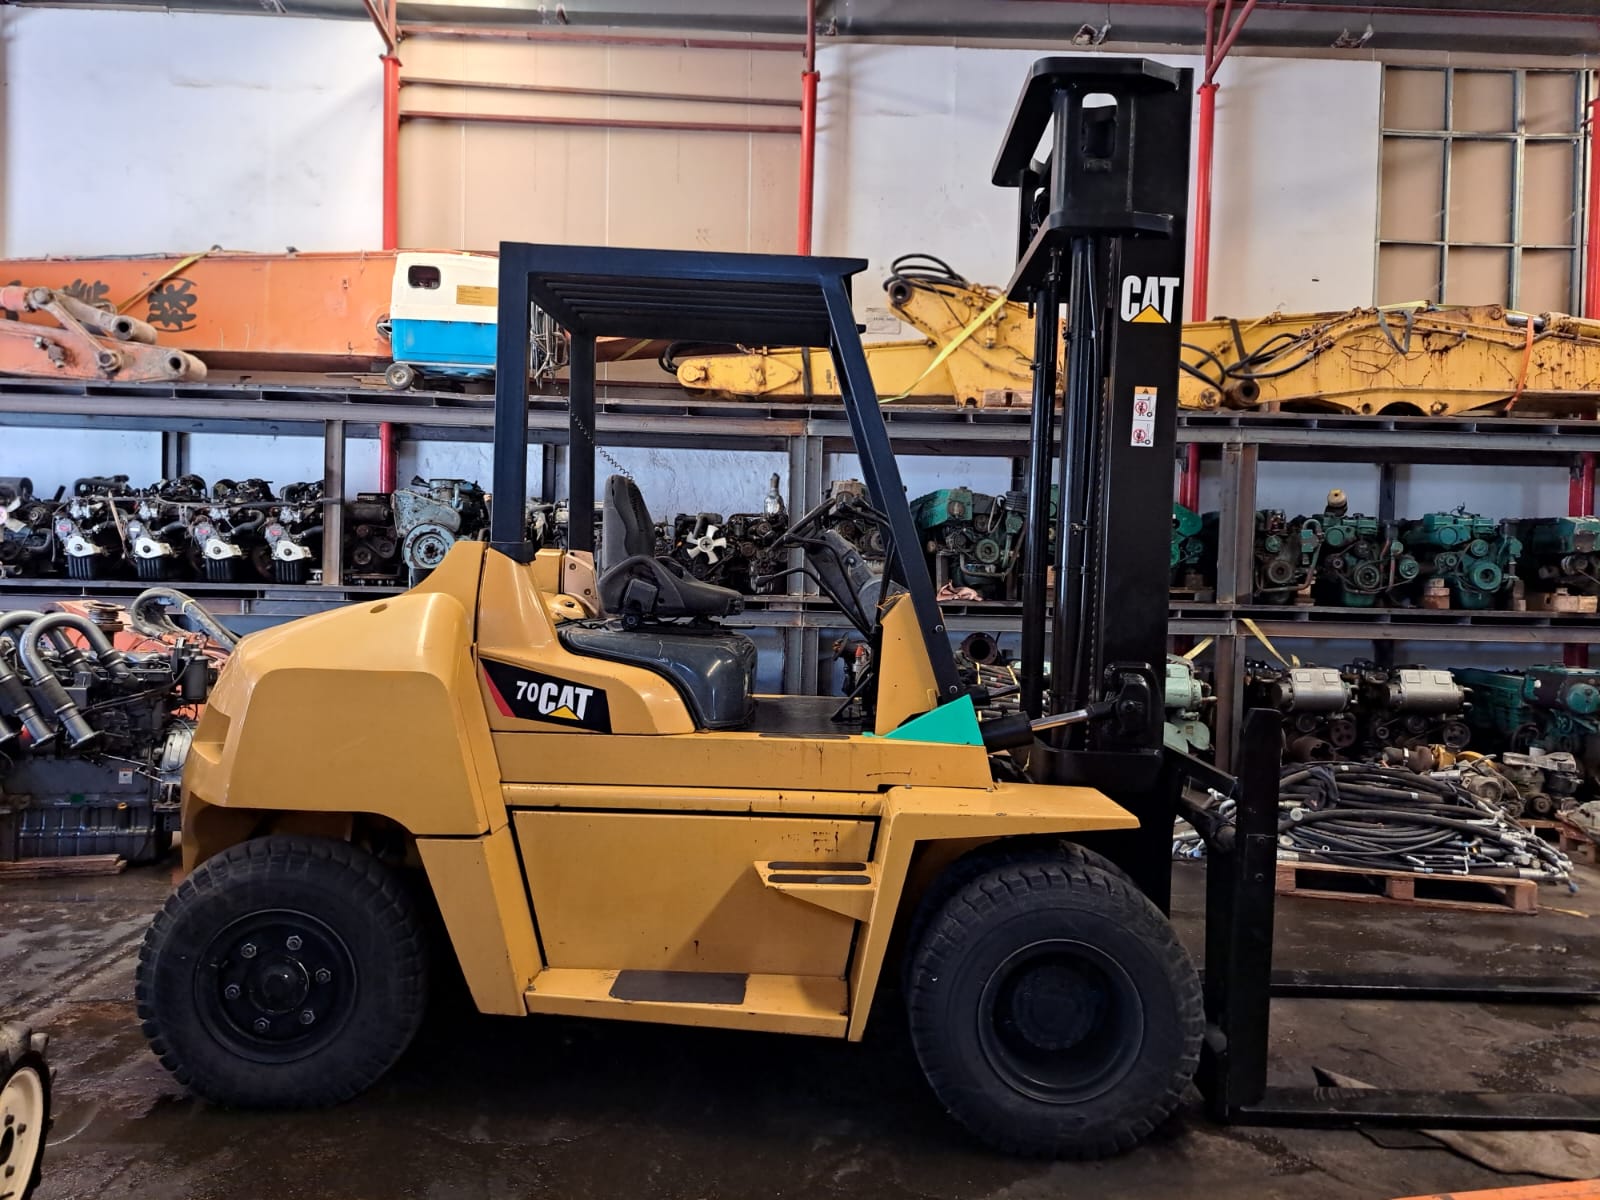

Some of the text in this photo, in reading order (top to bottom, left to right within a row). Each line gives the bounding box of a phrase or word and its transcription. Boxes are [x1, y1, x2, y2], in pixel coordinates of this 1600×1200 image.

[1120, 275, 1180, 324] CAT
[516, 681, 594, 720] 70 CAT
